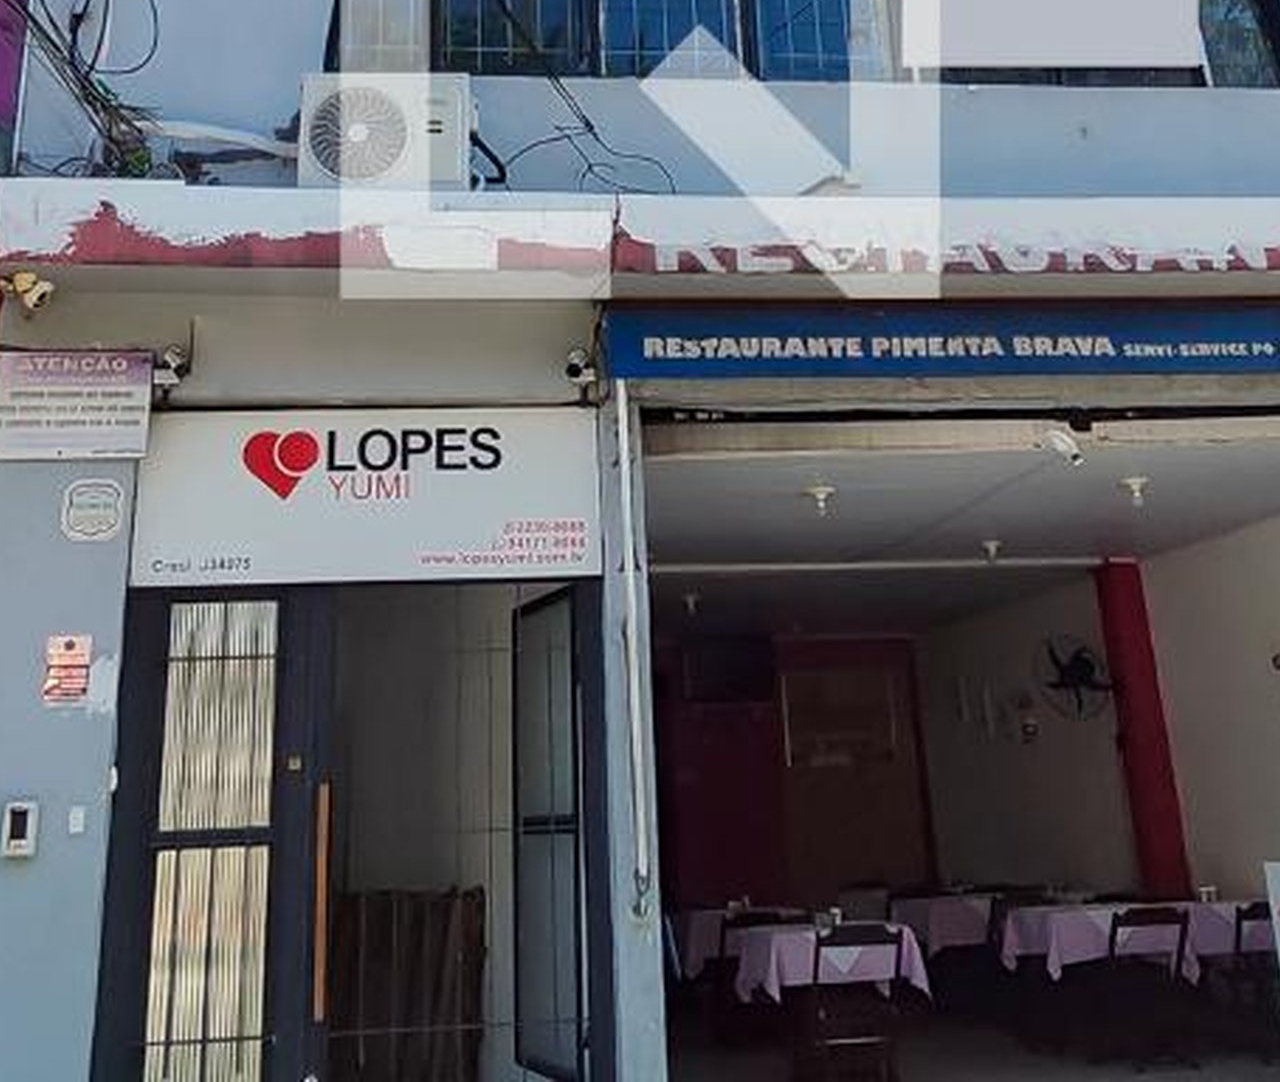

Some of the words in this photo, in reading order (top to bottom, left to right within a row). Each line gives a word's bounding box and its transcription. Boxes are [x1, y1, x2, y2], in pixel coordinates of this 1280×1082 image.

[643, 337, 864, 359] RESTAURANTE
[872, 337, 1005, 357] PIMENTA
[1013, 337, 1115, 357] BRAVA
[327, 427, 502, 472] LOPES
[328, 473, 410, 500] YUMI
